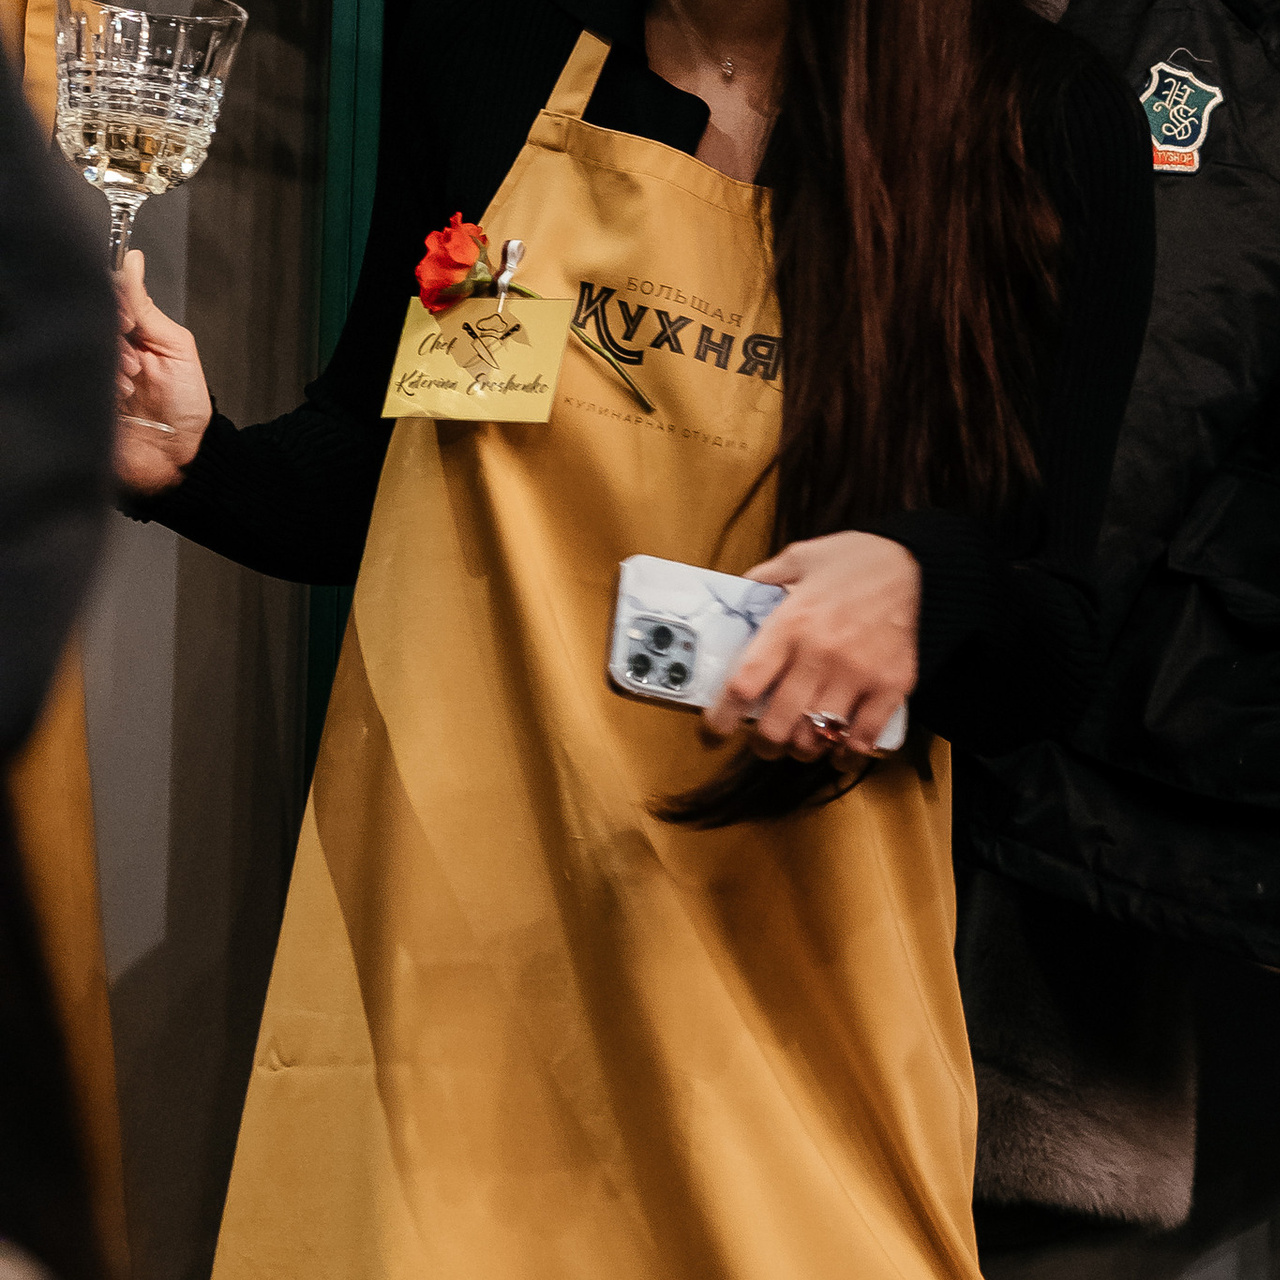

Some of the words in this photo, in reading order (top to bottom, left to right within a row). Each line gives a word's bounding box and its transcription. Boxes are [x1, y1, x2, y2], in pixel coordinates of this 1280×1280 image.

[627, 276, 744, 328] БОЛЬШАЯ
[417, 333, 458, 356] Chef
[395, 370, 458, 396] Katerina
